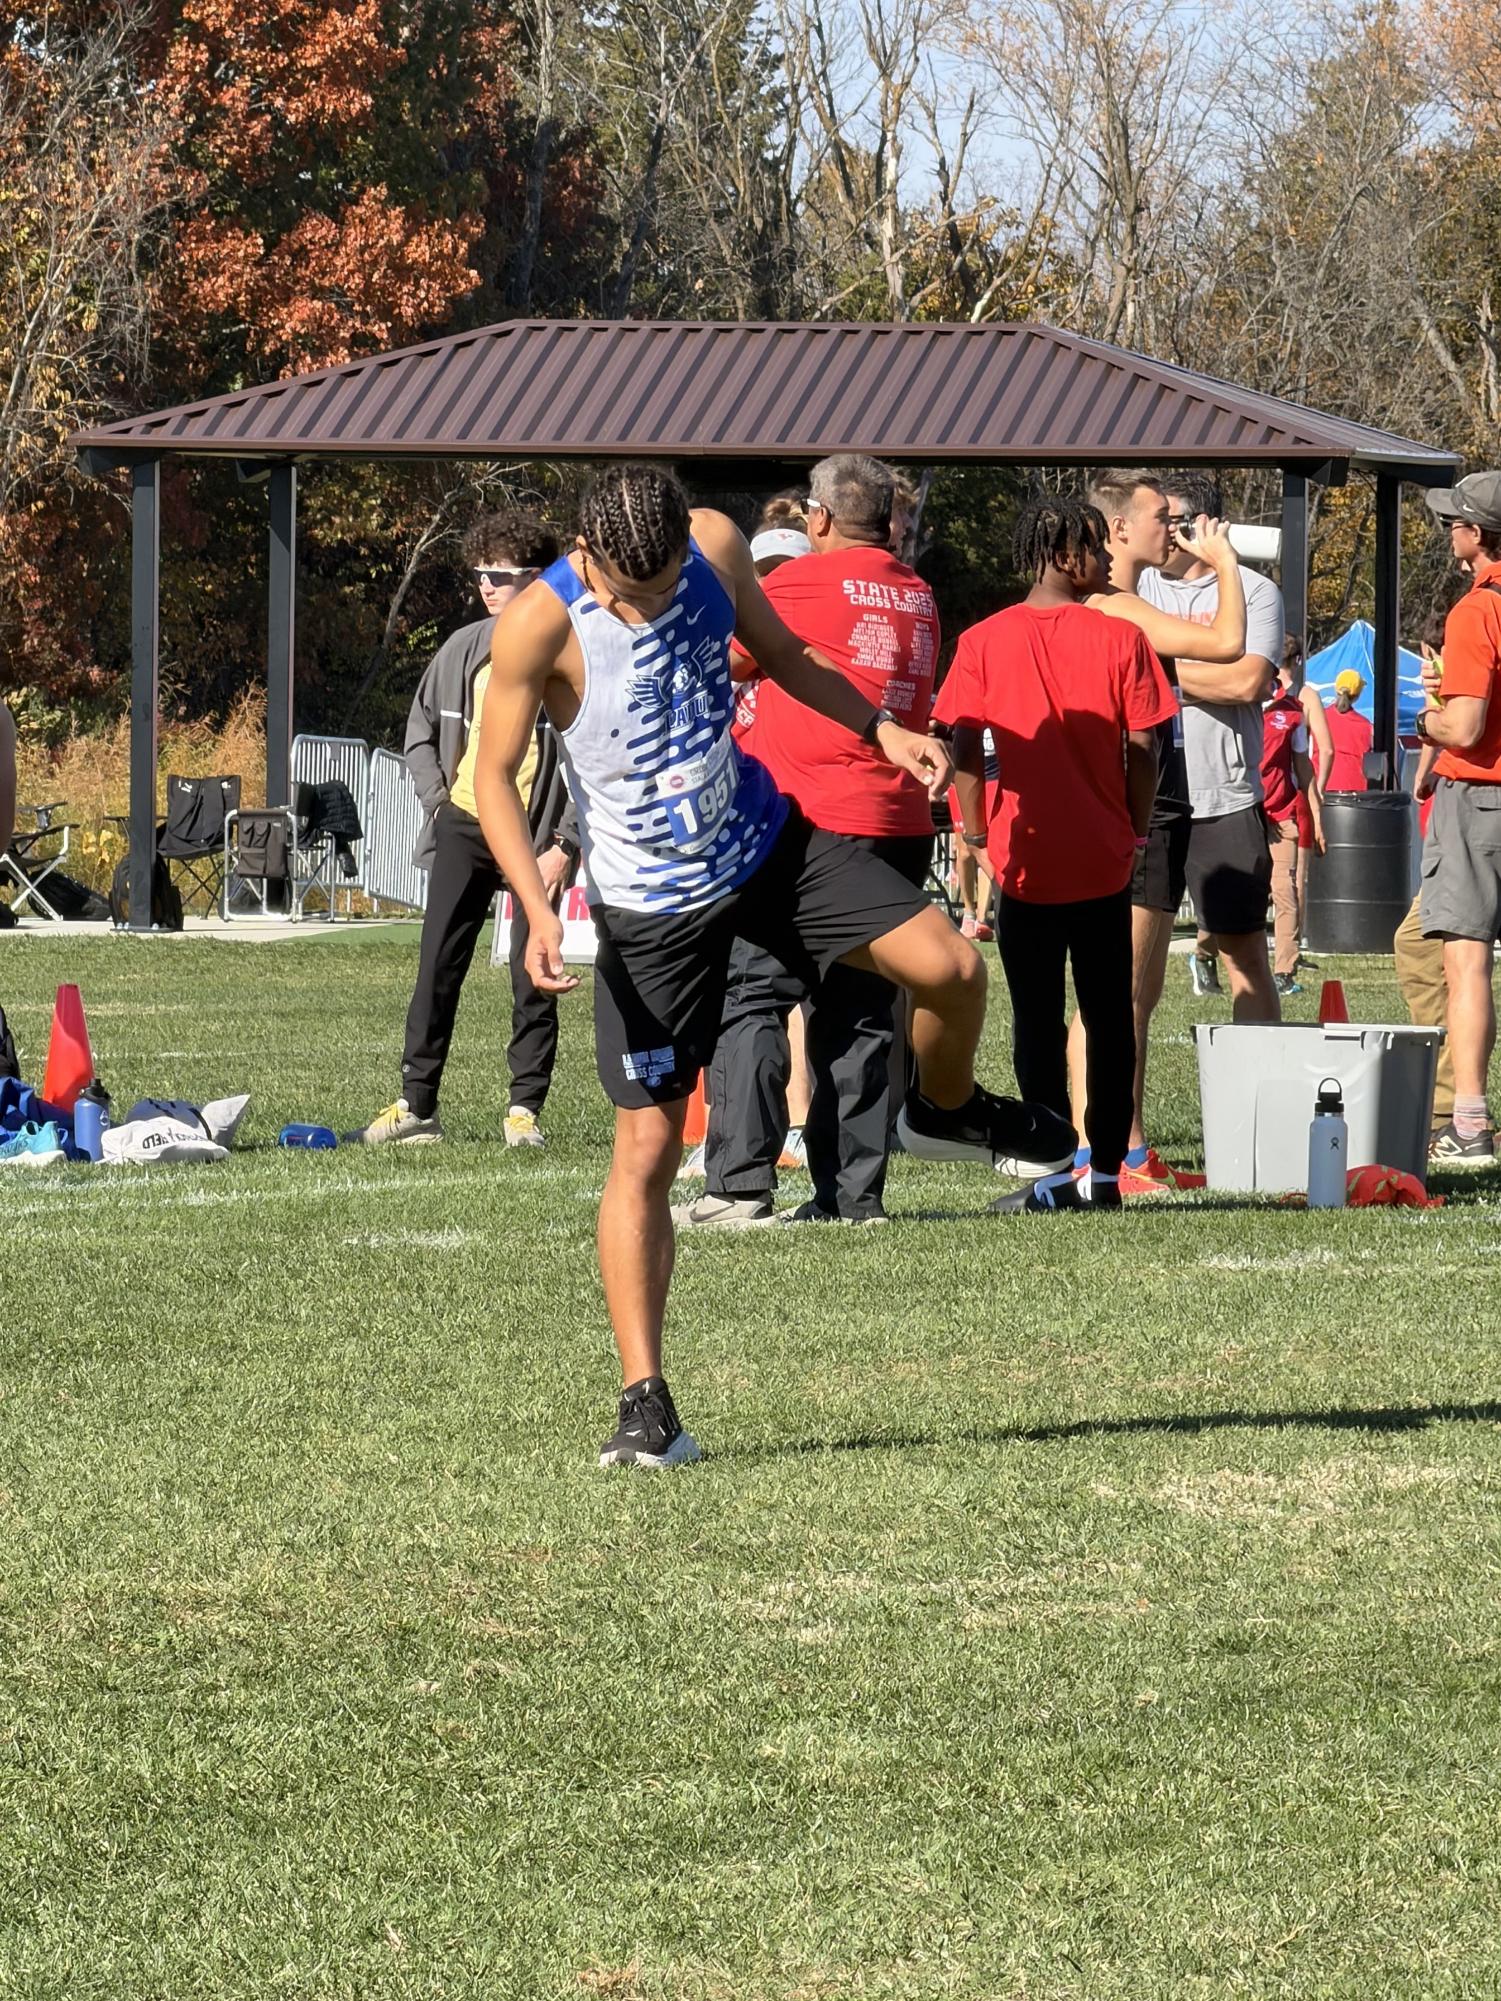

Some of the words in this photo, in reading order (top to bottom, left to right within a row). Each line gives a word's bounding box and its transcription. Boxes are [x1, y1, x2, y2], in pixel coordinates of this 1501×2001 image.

[842, 579, 900, 601] STATE
[902, 588, 934, 607] 2025
[849, 594, 891, 609] CROSS
[894, 601, 933, 617] COUNTRY
[863, 613, 888, 624] GIRLS
[673, 756, 738, 834] 1951
